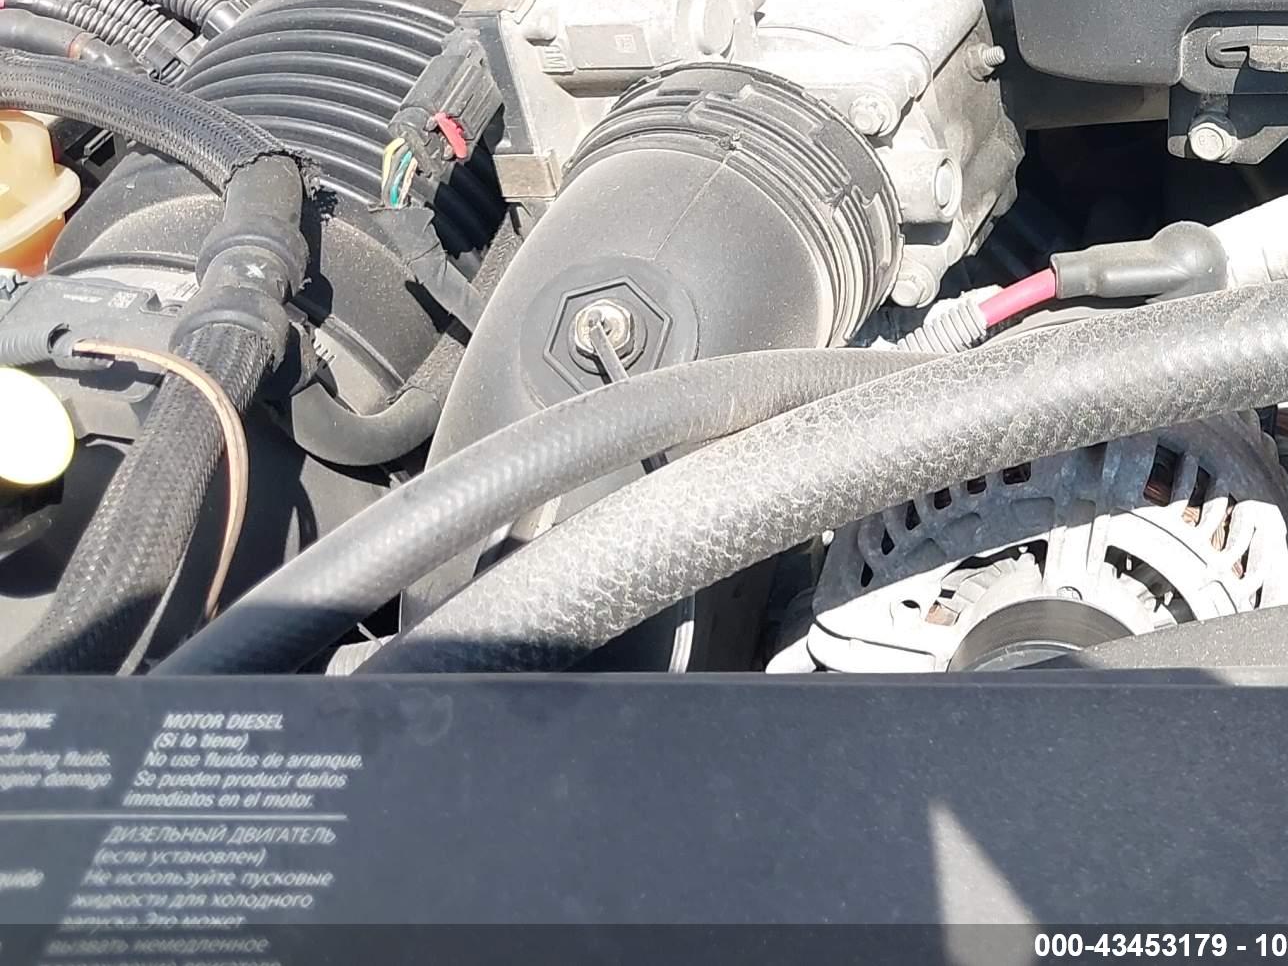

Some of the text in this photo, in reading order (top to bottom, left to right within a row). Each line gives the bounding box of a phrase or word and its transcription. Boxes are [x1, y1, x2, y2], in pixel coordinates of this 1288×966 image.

[162, 713, 284, 730] MOTOR DIESEL
[153, 732, 249, 751] (Si lo tiene)
[143, 752, 364, 770] No use fluidos de arranque.
[134, 770, 348, 789] Se pueden producir daños
[122, 790, 214, 807] inmediatos
[217, 793, 241, 807] en
[243, 791, 261, 807] el
[104, 824, 337, 845] ДИЗЕЛЬНЫЙ ДВИГАТЕЛЬ
[94, 848, 267, 866] (если установлен)
[113, 869, 237, 888] используйте
[241, 872, 334, 888] пусковые
[71, 893, 314, 910] жидкости для холодного
